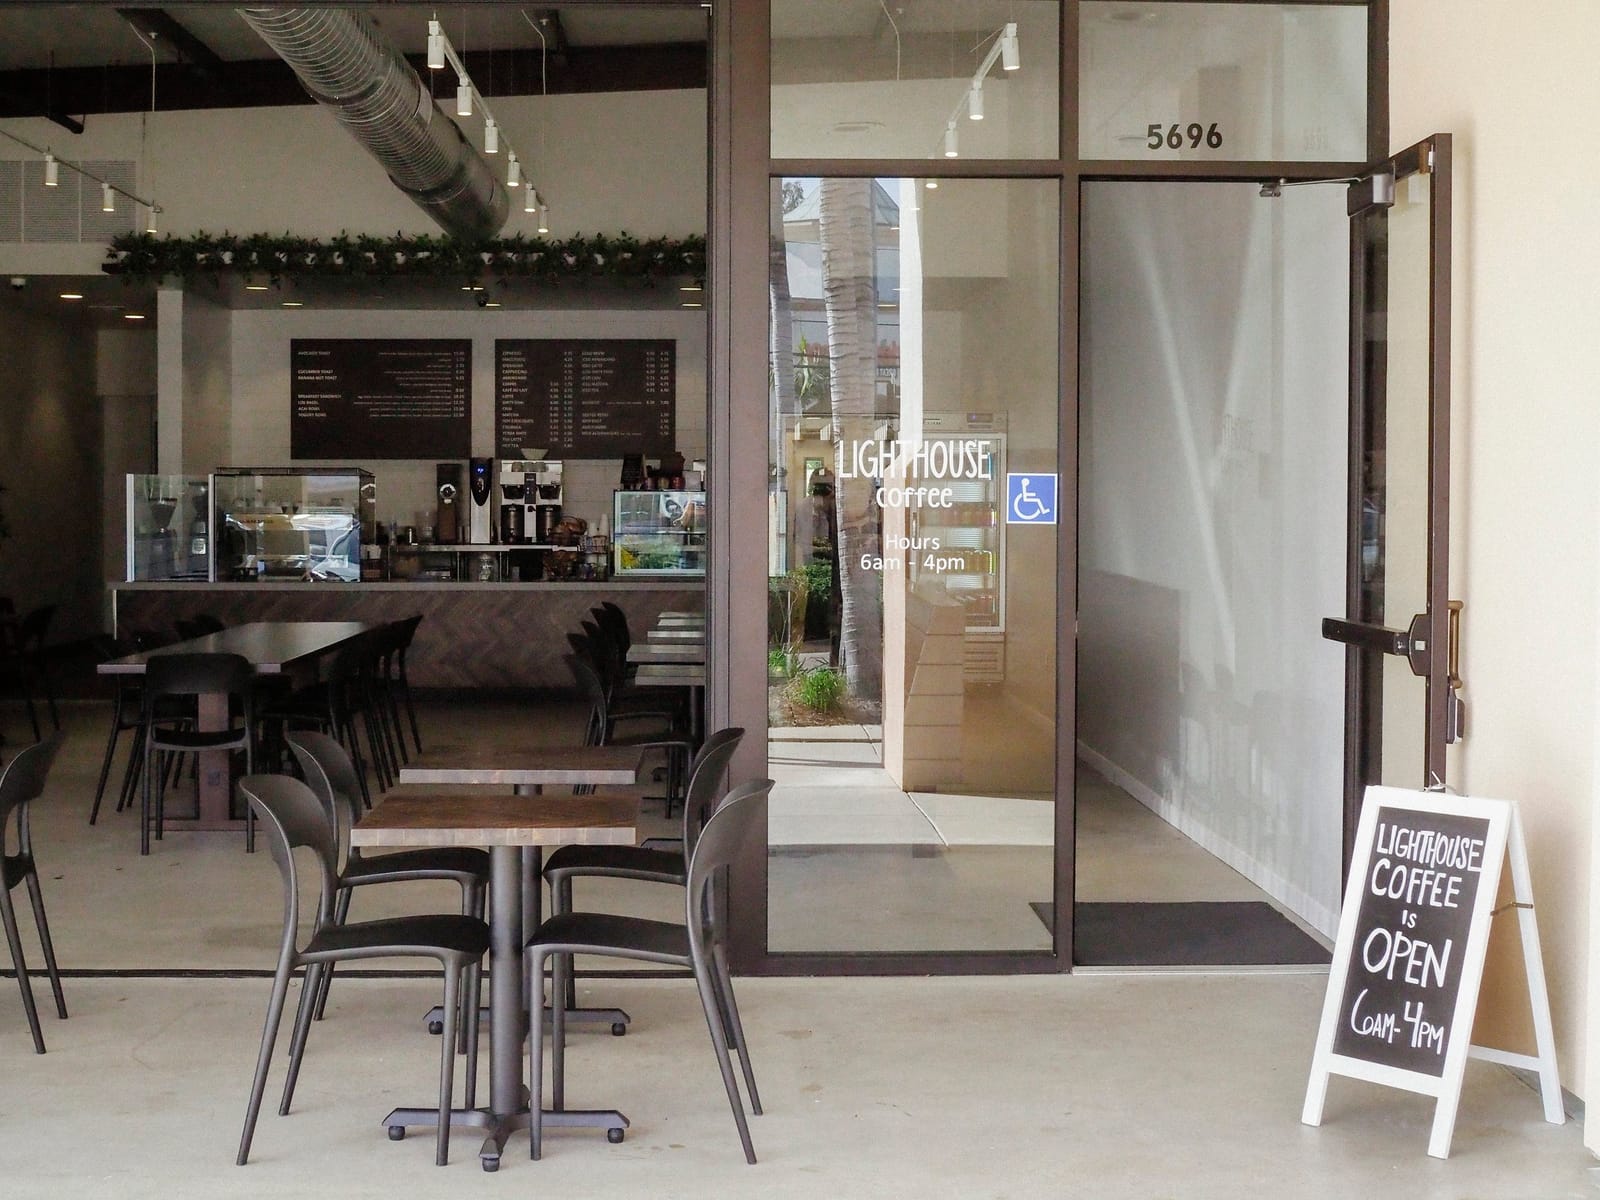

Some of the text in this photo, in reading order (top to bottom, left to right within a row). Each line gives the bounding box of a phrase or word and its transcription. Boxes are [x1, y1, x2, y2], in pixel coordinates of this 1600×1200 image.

[1147, 122, 1223, 149] 5696
[838, 439, 991, 479] LIGHTHOUSE
[876, 486, 953, 508] coffee
[886, 534, 940, 550] Hours
[860, 554, 900, 571] 6am
[923, 554, 965, 574] 4pm
[1376, 823, 1483, 873] LIGHTHOUSE
[1371, 858, 1462, 908] COFFEE
[1363, 927, 1452, 988] OPEN
